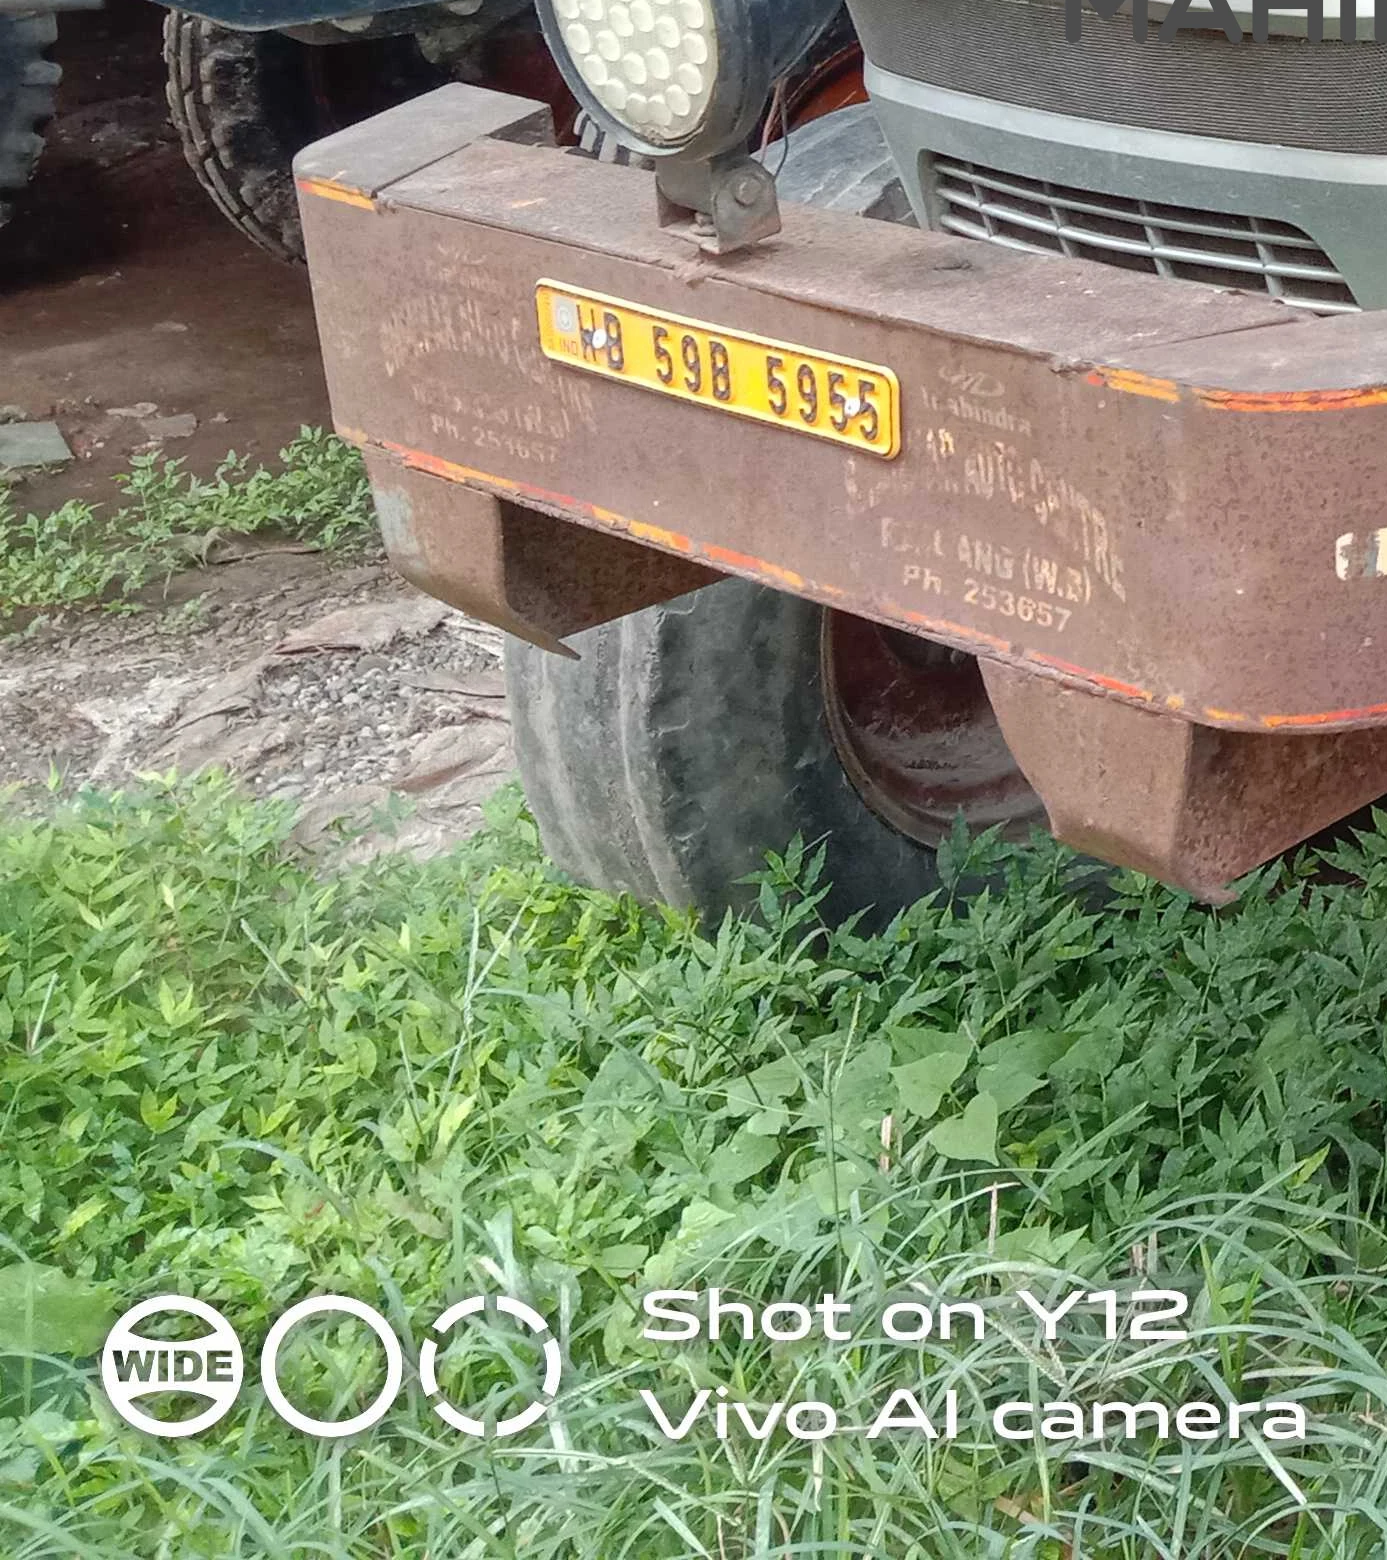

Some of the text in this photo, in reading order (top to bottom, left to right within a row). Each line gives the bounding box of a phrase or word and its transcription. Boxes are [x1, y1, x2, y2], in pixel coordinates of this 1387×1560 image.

[652, 325, 730, 401] 59B
[765, 356, 879, 441] 5955
[963, 577, 1073, 633] 253657
